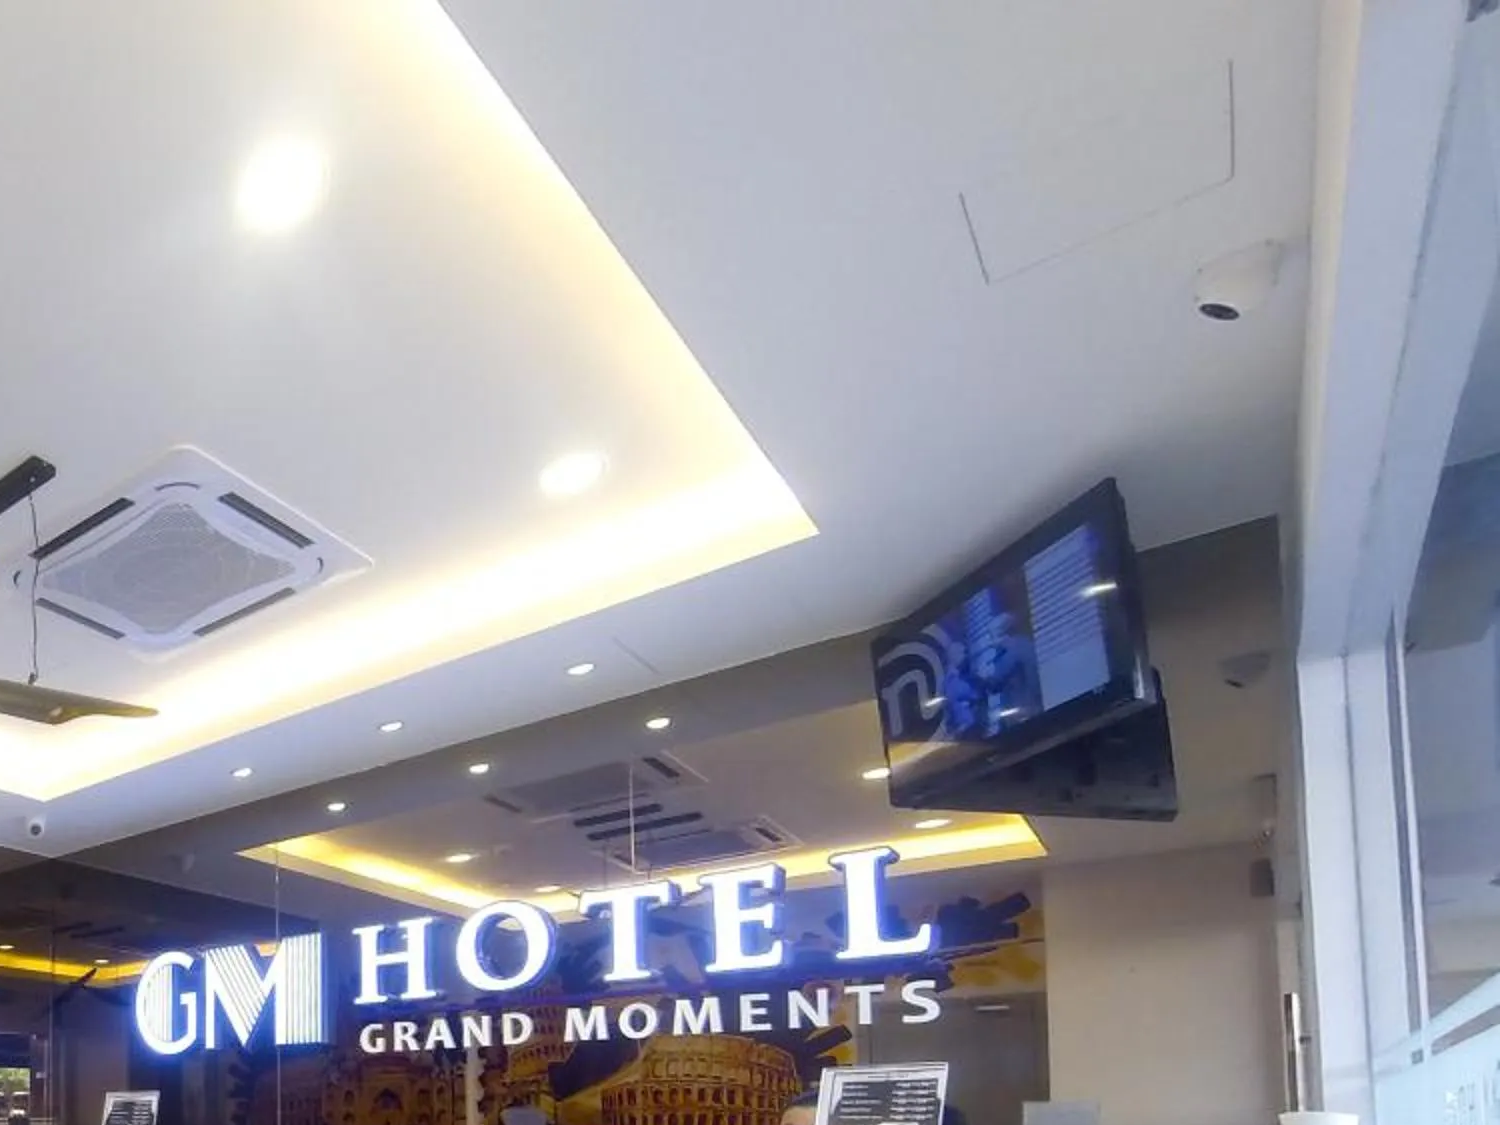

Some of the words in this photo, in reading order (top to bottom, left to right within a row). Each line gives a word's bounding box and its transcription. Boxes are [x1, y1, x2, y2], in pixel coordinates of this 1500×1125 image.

[136, 932, 322, 1055] GM
[352, 847, 934, 1005] HOTEL
[359, 1012, 535, 1054] GRAND
[564, 979, 942, 1043] MOMENTS
